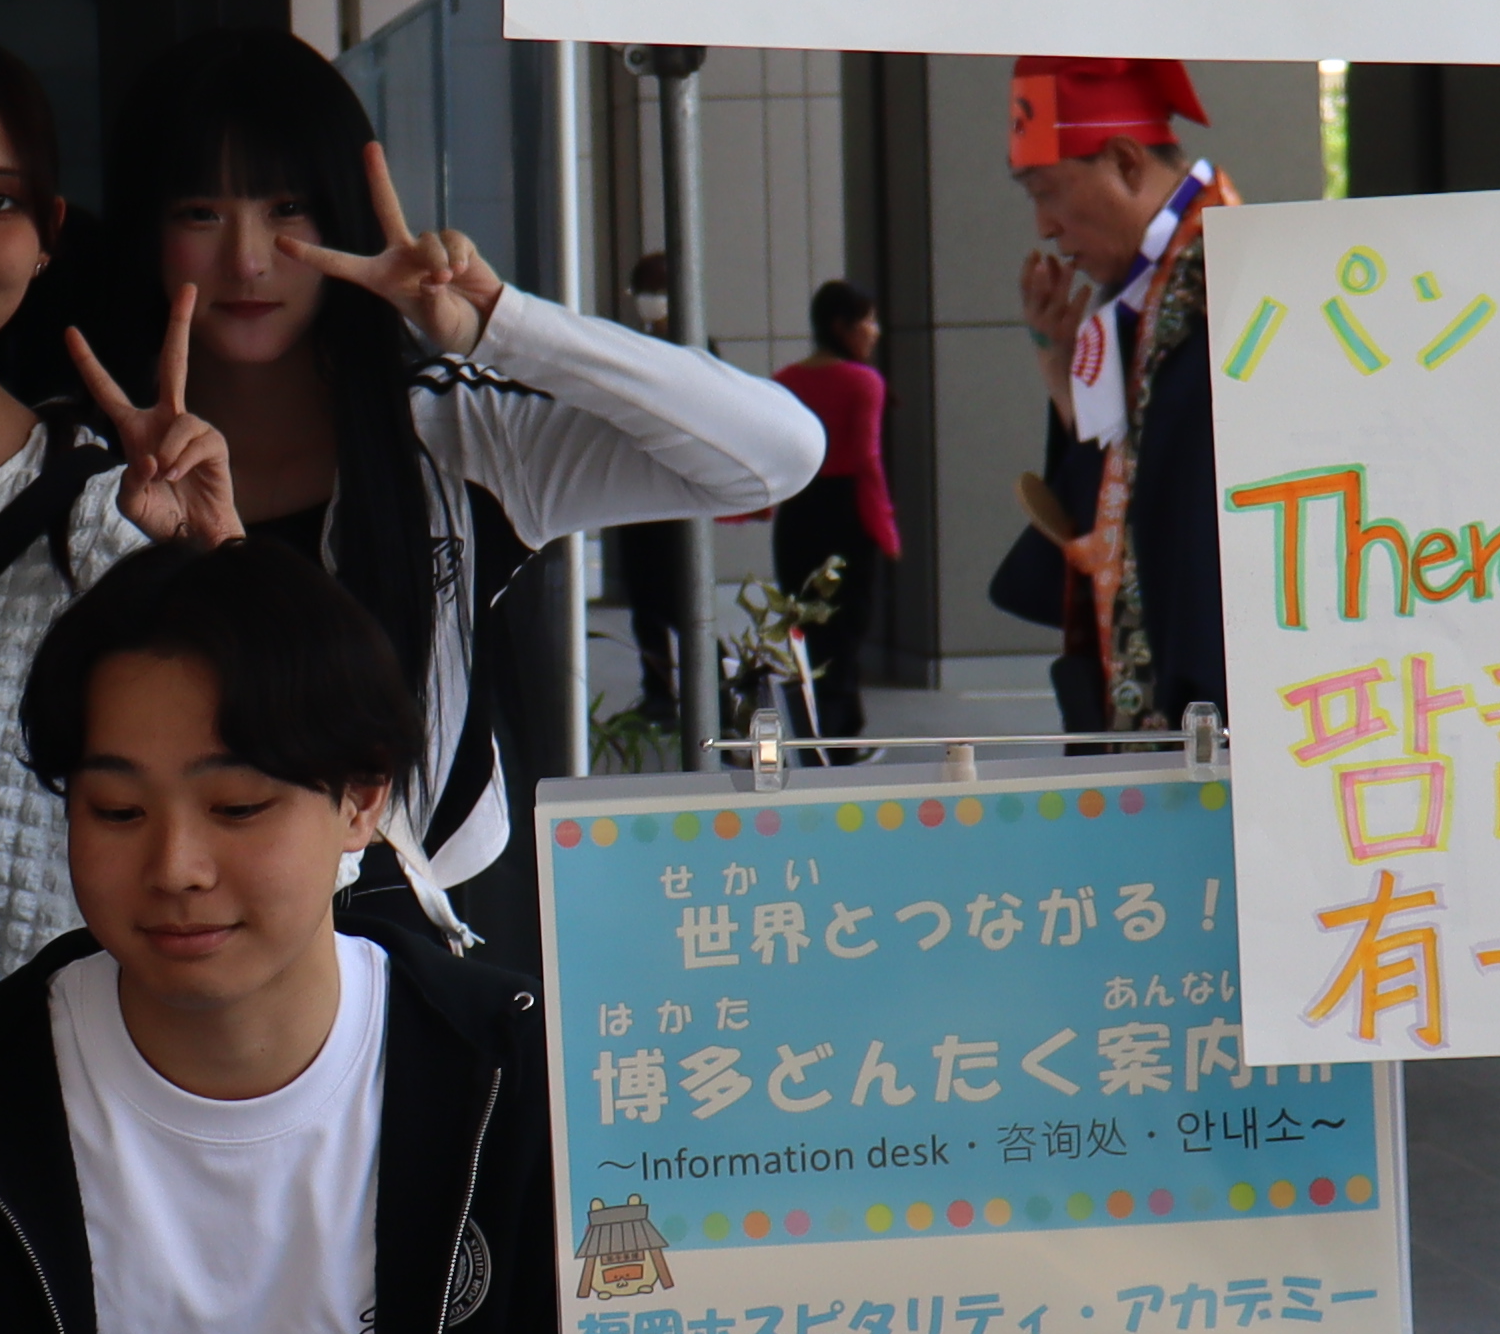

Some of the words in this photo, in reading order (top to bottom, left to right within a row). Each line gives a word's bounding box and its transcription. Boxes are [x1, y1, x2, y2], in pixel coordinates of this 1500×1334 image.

[592, 1016, 1333, 1126] 博多どんたく案内
[866, 1132, 950, 1172] desk
